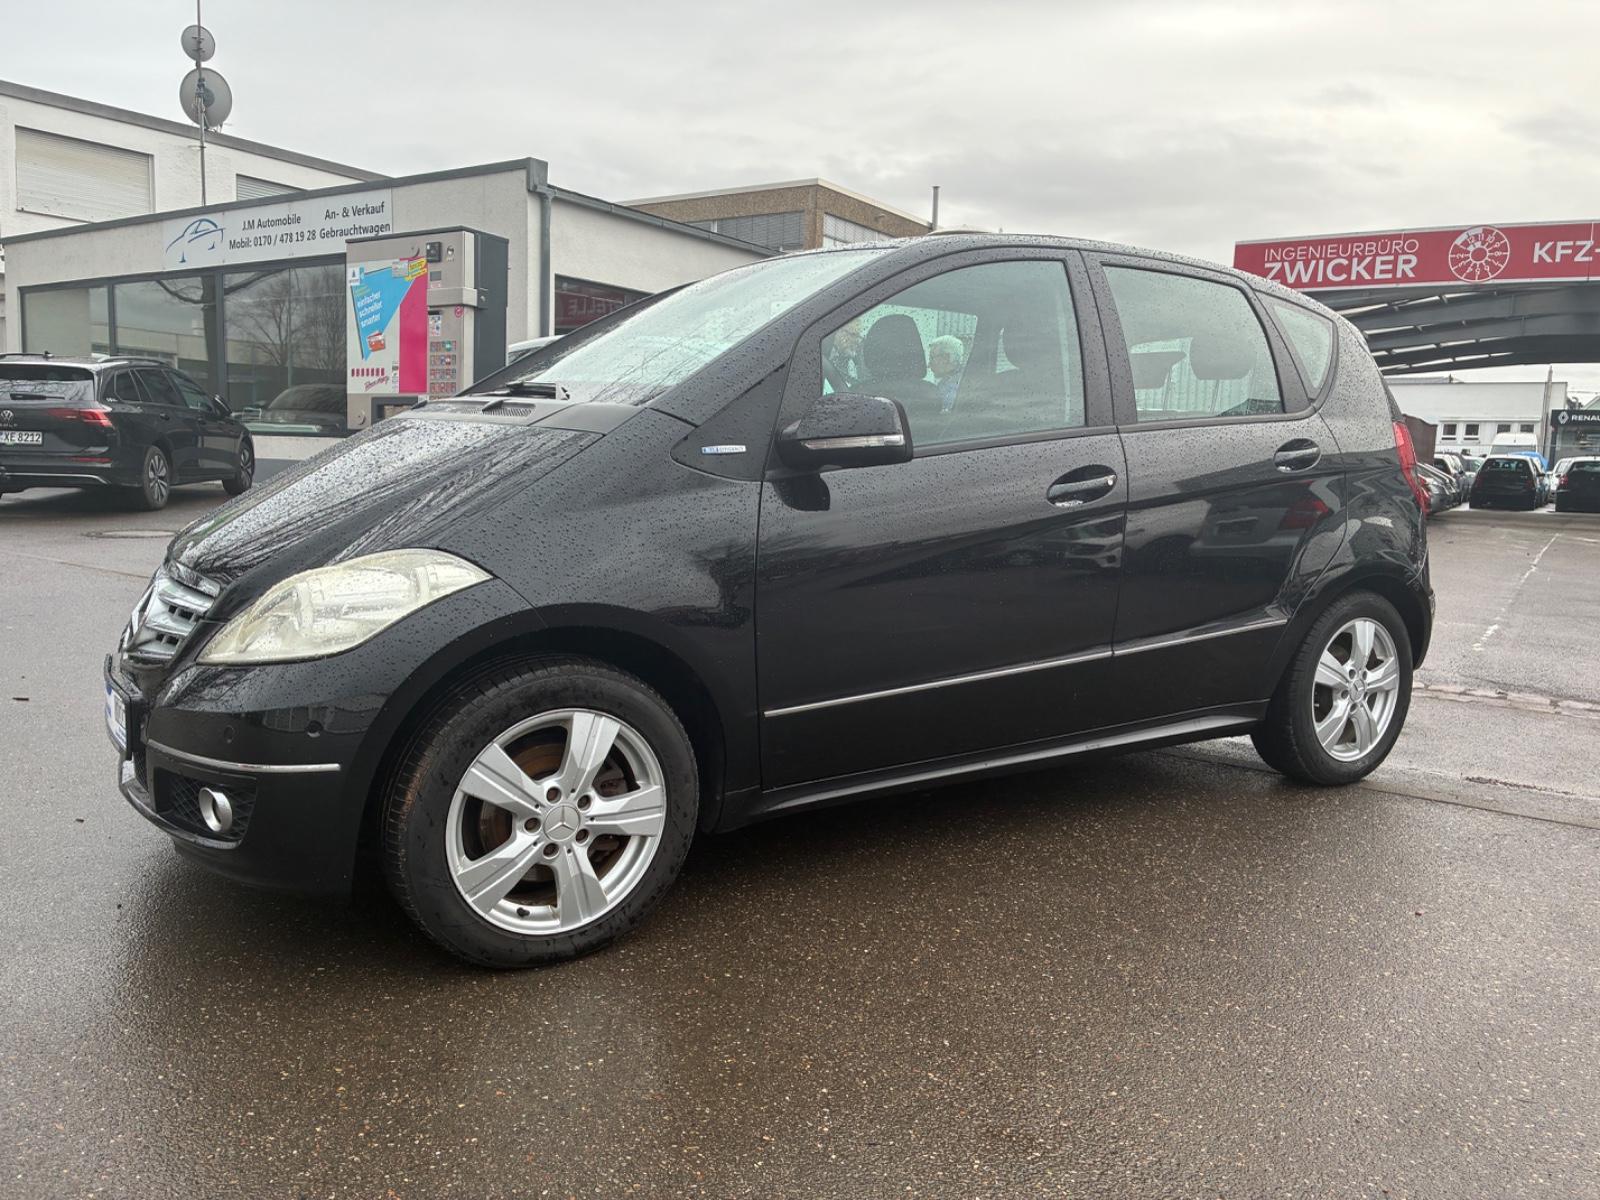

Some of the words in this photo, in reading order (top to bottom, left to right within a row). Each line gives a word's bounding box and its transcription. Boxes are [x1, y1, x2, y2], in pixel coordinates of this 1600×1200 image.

[324, 208, 340, 220] An-
[342, 206, 350, 218] &
[352, 201, 385, 217] Verkauf
[257, 213, 302, 229] Automobile
[229, 237, 252, 250] Mobil:
[254, 234, 272, 247] 0170
[280, 232, 293, 243] 478
[295, 230, 305, 242] 19
[306, 229, 317, 241] 28
[319, 223, 391, 239] Gebrauchtwagen
[1264, 238, 1420, 262] INGENIEURBÜRO
[1264, 254, 1418, 284] ZWICKER
[18, 432, 41, 443] 8212
